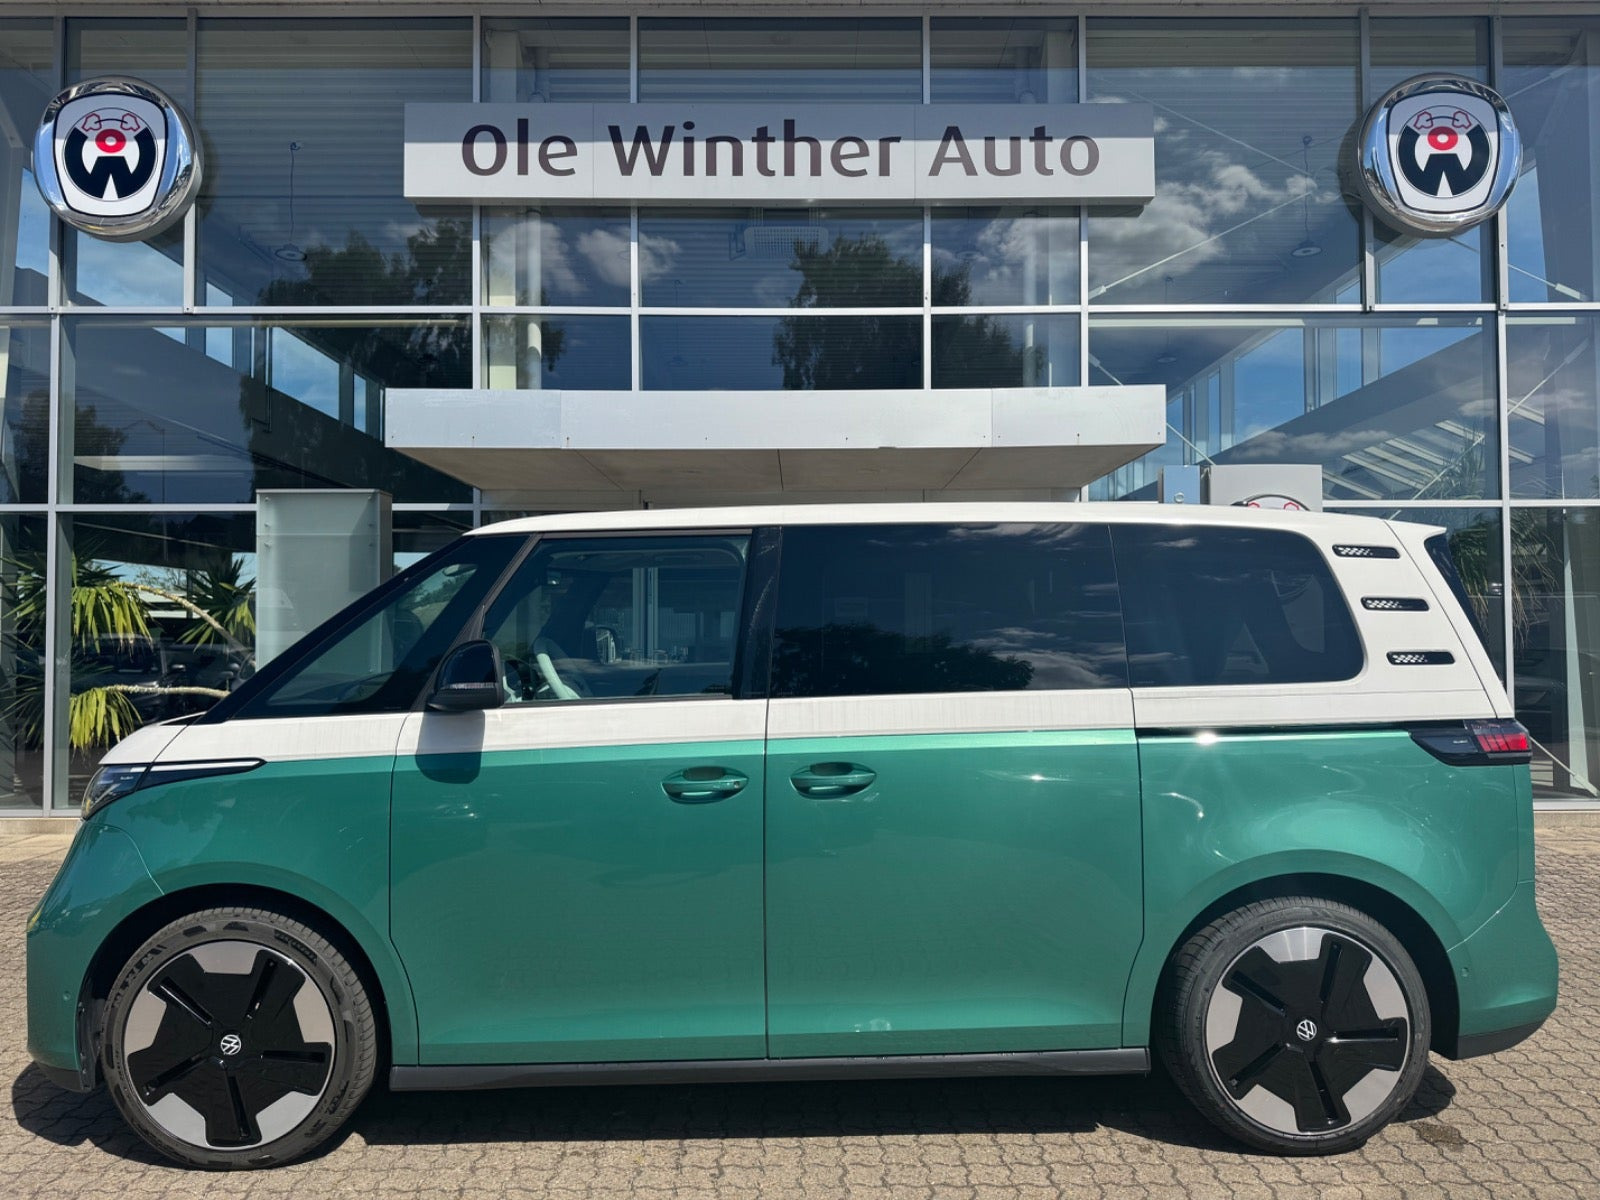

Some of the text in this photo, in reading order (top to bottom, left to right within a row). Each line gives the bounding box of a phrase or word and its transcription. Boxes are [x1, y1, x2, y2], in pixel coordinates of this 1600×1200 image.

[461, 118, 1100, 177] Ole Winther Auto
